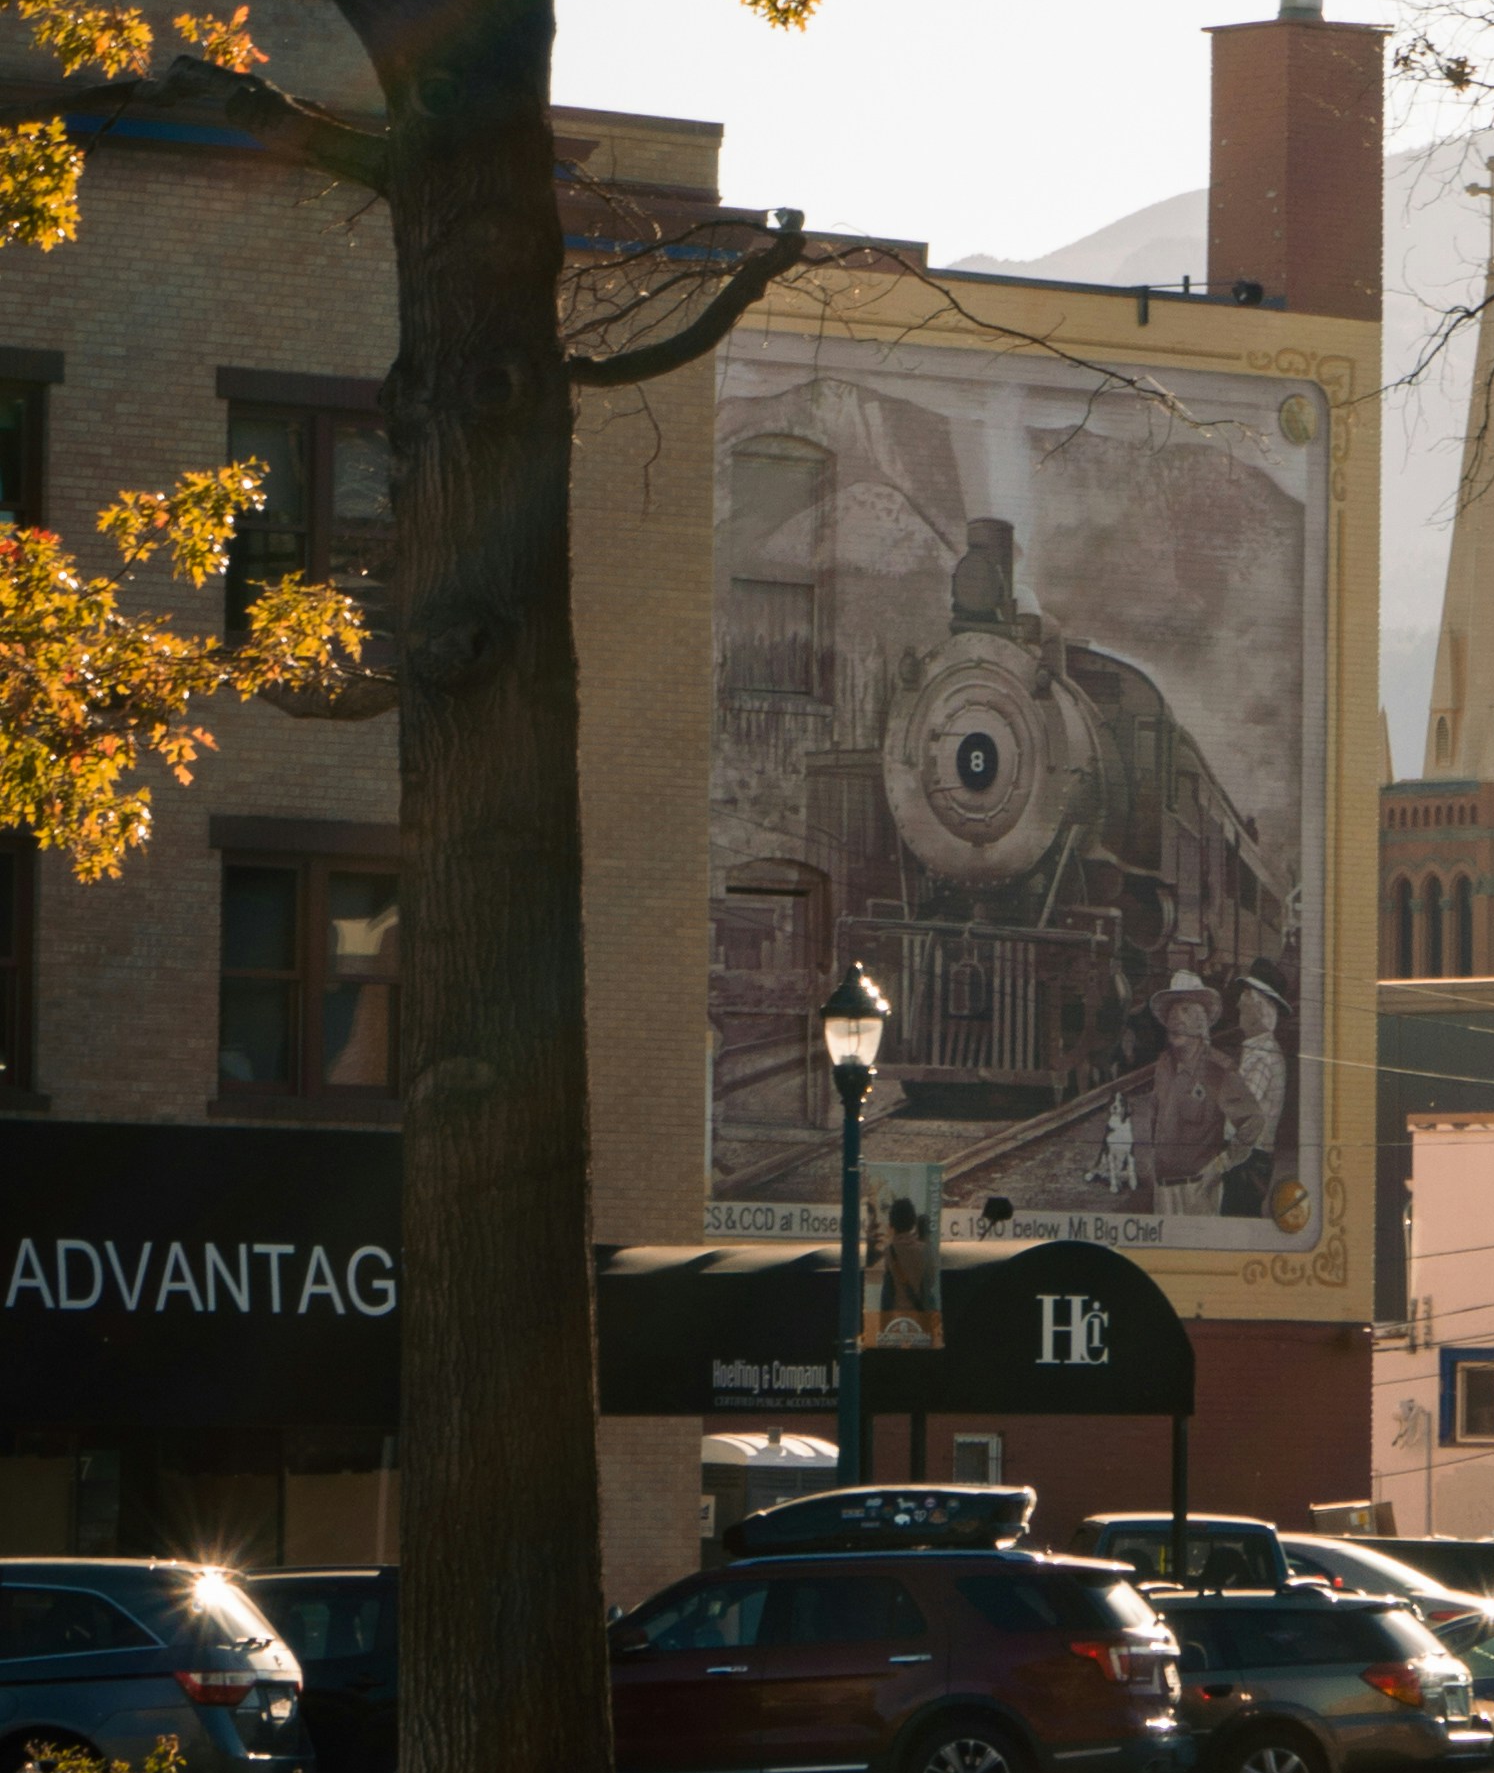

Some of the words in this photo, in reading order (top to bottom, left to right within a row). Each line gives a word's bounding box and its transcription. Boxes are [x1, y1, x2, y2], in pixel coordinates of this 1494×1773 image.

[970, 750, 984, 772] 8
[780, 1212, 793, 1231] at
[801, 1208, 842, 1232] Rose
[1013, 1218, 1059, 1239] below
[1094, 1217, 1118, 1246] Big
[1123, 1218, 1164, 1242] Chief
[5, 1238, 397, 1316] ADVANTAG
[762, 1364, 770, 1388] &
